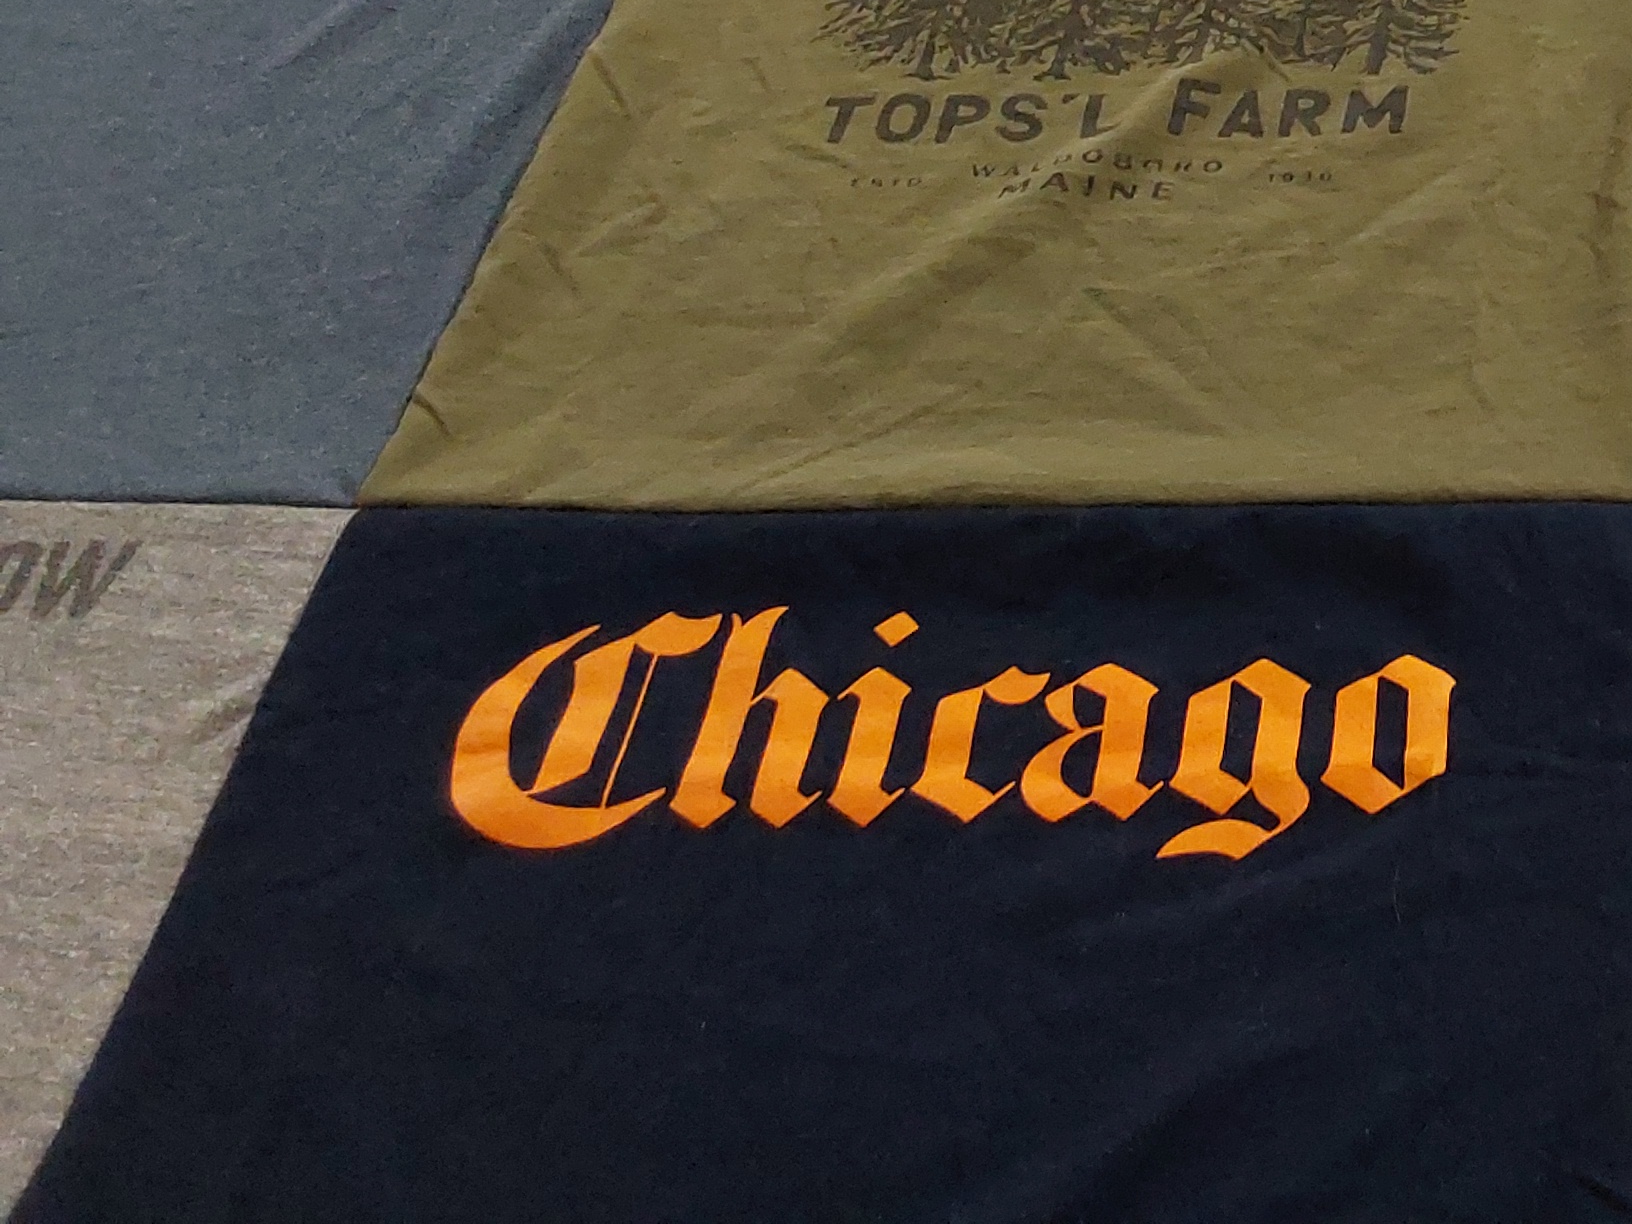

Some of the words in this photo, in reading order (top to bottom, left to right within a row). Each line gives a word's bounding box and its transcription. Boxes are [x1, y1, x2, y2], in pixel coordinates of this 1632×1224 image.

[1165, 78, 1410, 138] FARM
[998, 171, 1175, 200] MAINE
[450, 605, 1456, 860] Chicago
